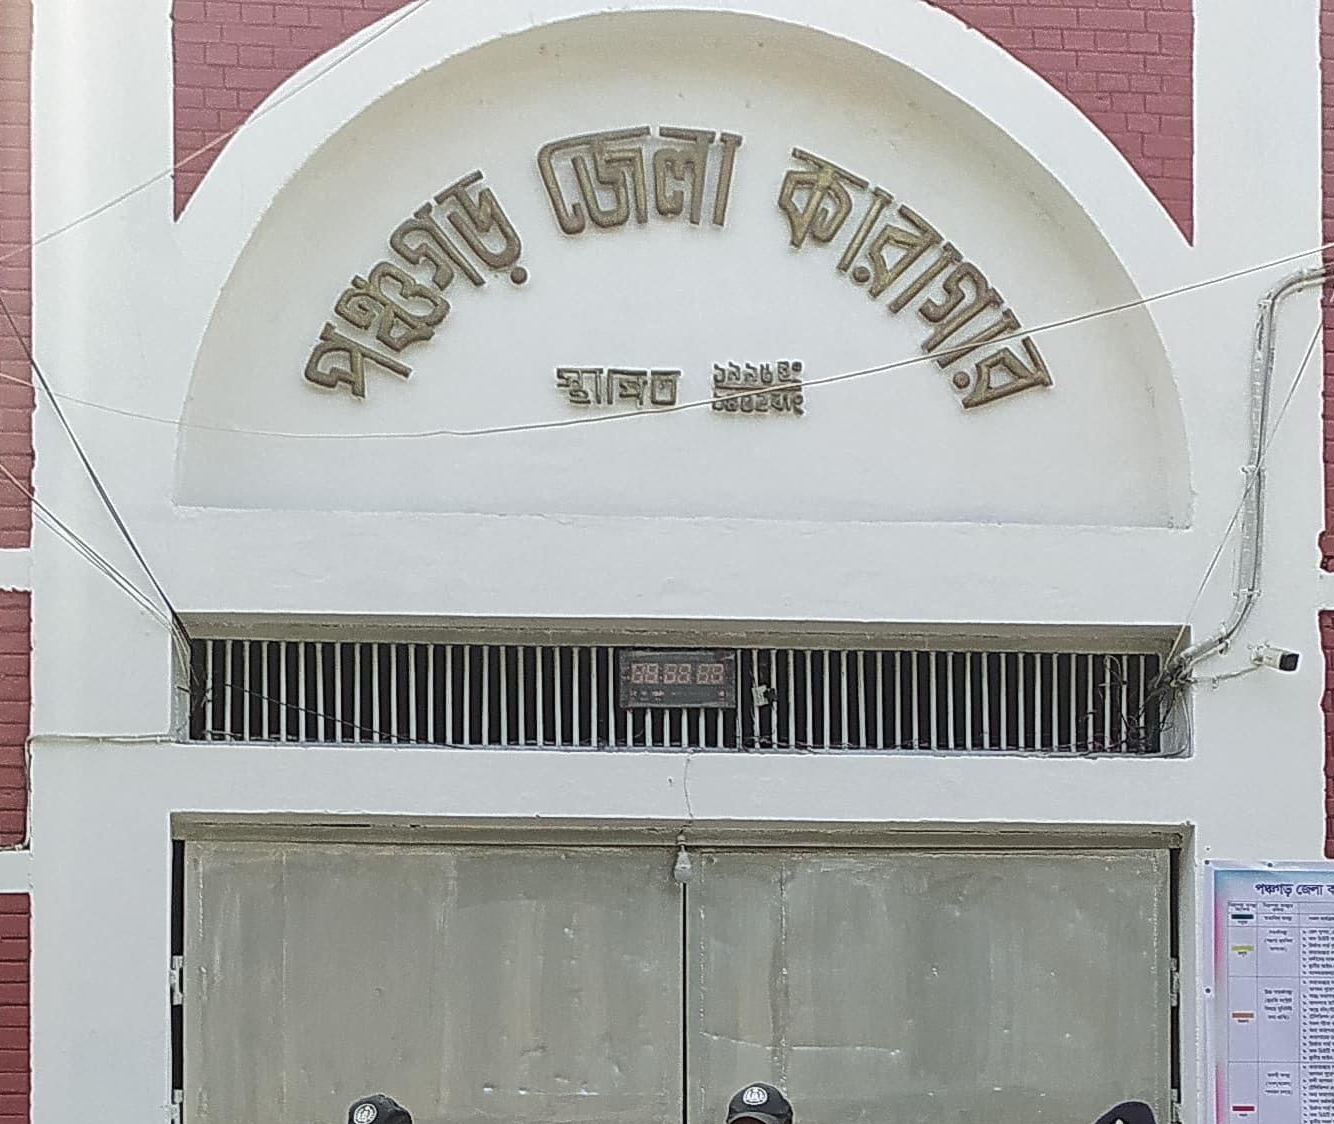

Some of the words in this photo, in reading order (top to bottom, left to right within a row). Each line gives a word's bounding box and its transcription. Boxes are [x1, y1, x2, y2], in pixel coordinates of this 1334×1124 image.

[304, 169, 530, 399] পঞ্চগড়
[536, 125, 744, 236] জেলা
[777, 146, 1054, 409] কারাগার
[1255, 883, 1294, 897] পঞ্চগড়
[1296, 884, 1323, 896] জেলা
